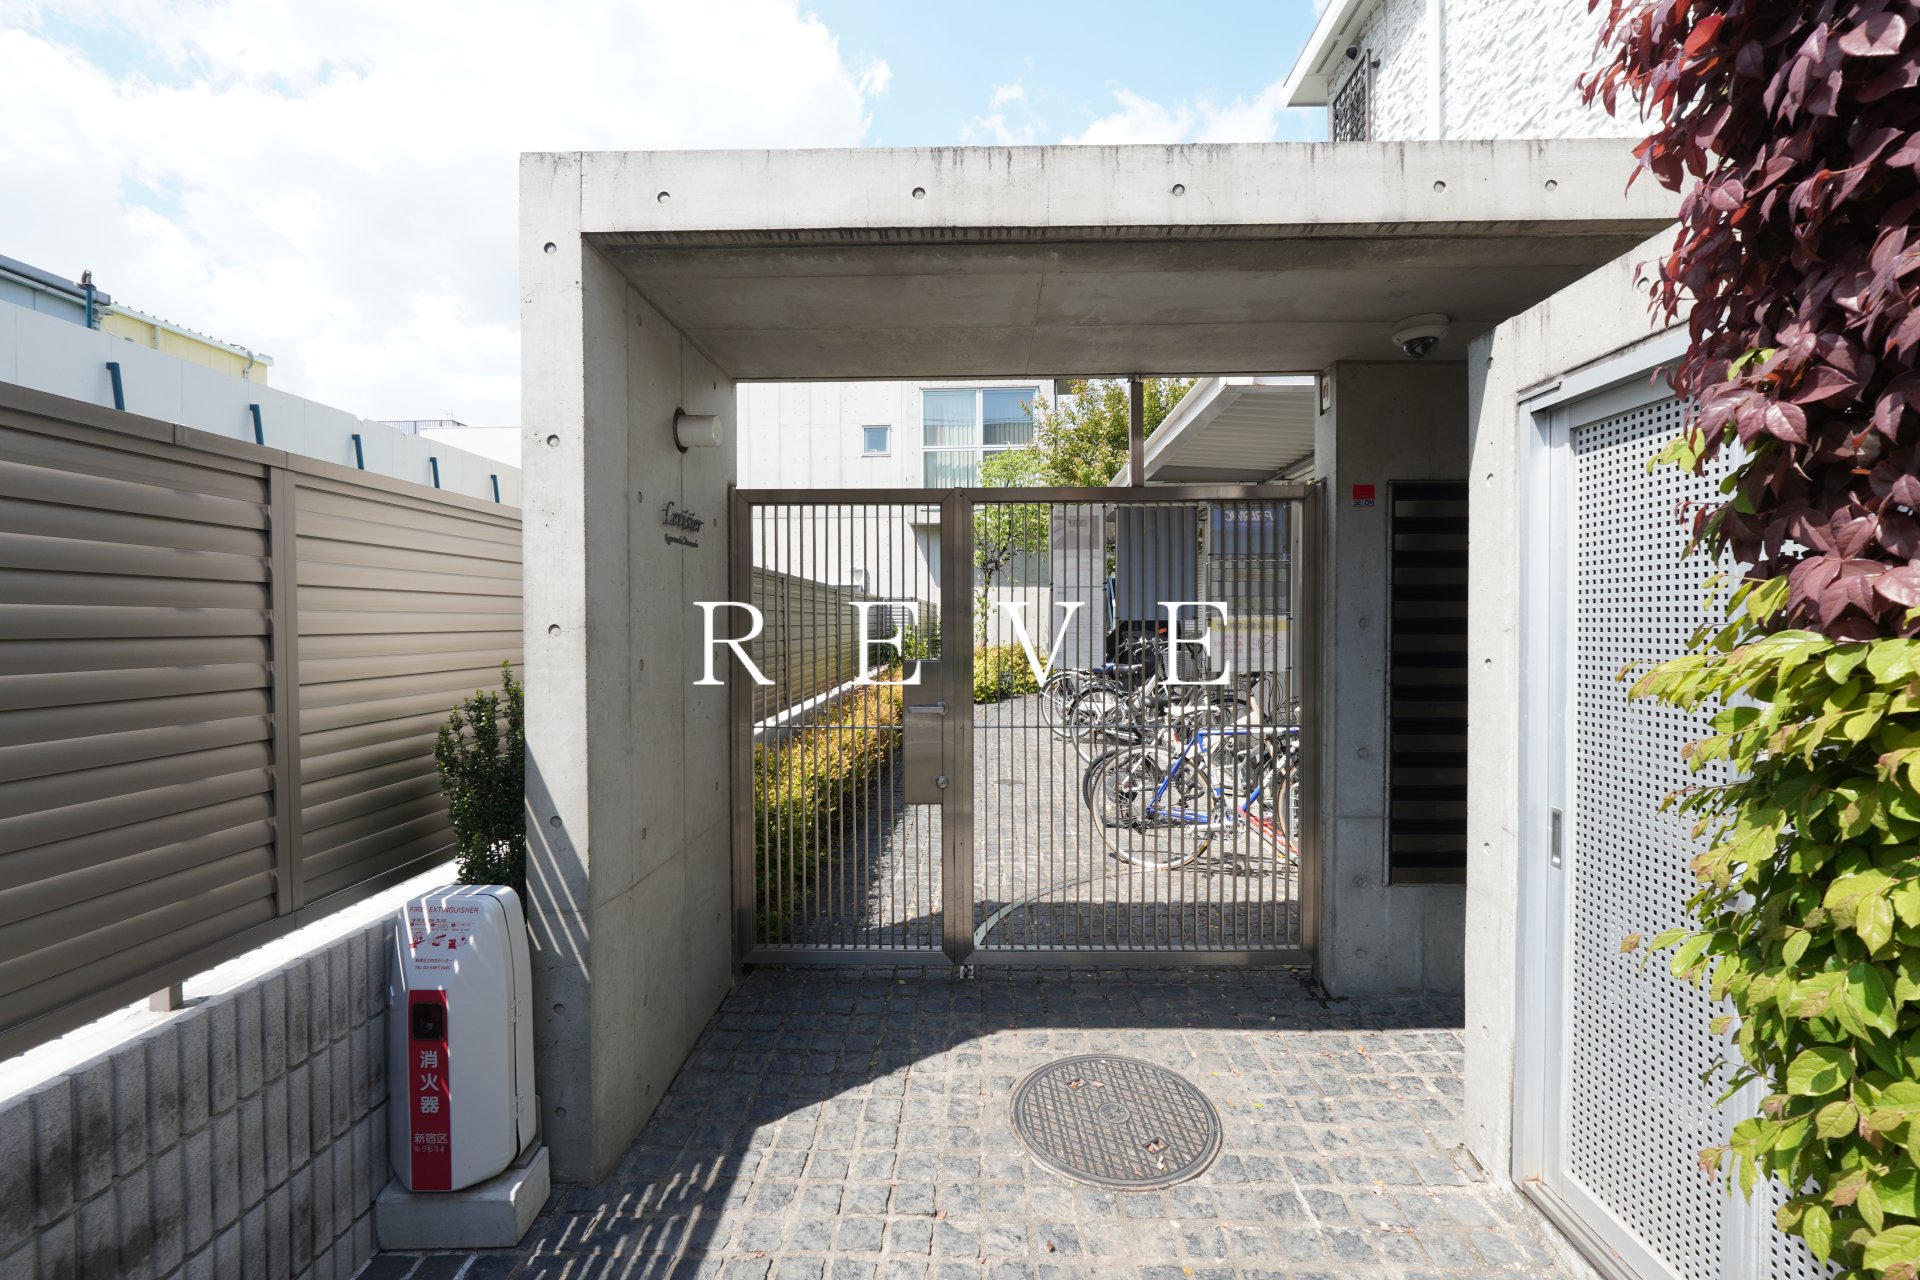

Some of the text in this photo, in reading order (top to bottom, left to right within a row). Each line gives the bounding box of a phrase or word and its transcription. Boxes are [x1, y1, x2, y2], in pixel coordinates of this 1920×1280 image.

[428, 906, 479, 914] EXTINGUISHER
[419, 1050, 440, 1114] 消火器
[414, 1133, 448, 1144] 新宿区
